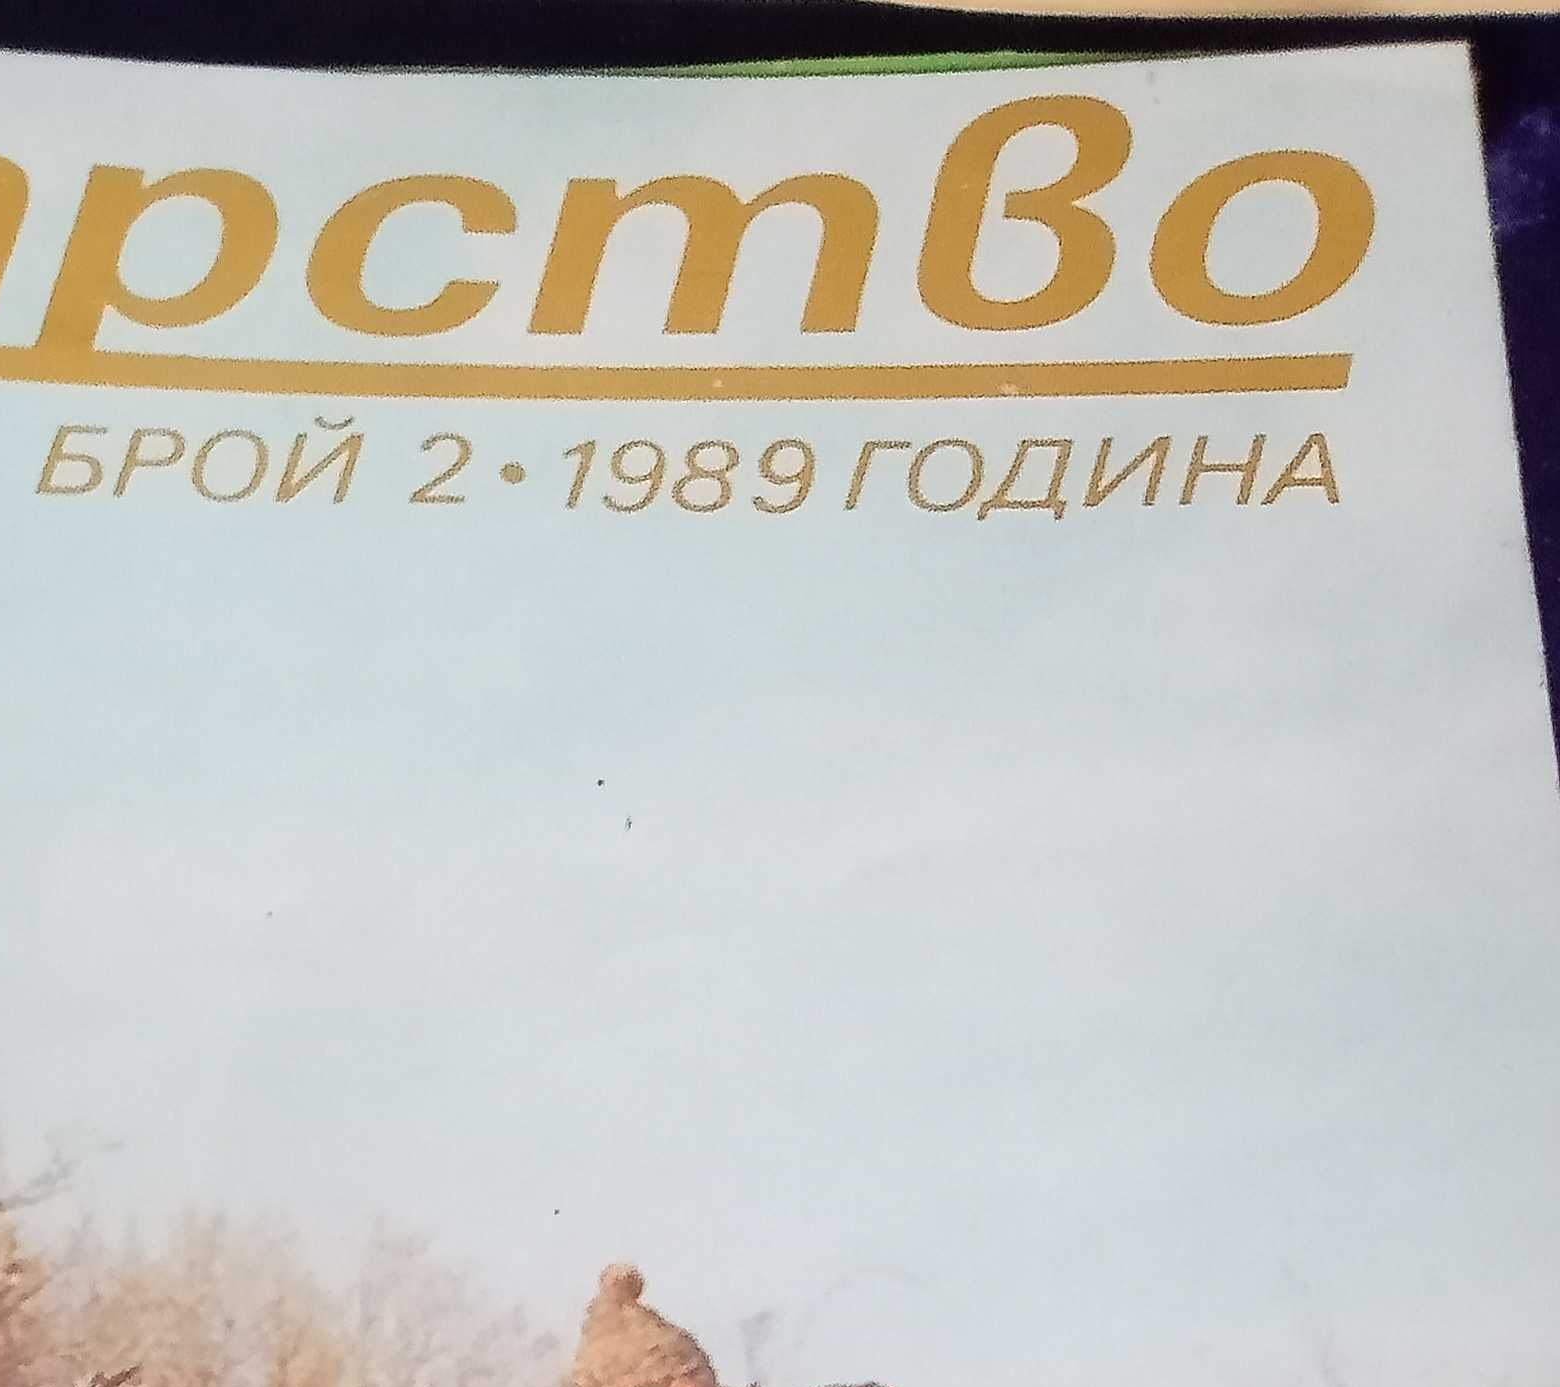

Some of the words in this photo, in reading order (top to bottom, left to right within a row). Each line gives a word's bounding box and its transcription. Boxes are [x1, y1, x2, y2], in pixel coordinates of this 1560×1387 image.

[37, 416, 365, 504] БРОЙ
[567, 438, 819, 514] 1989
[843, 433, 1345, 521] ГОДИНА
